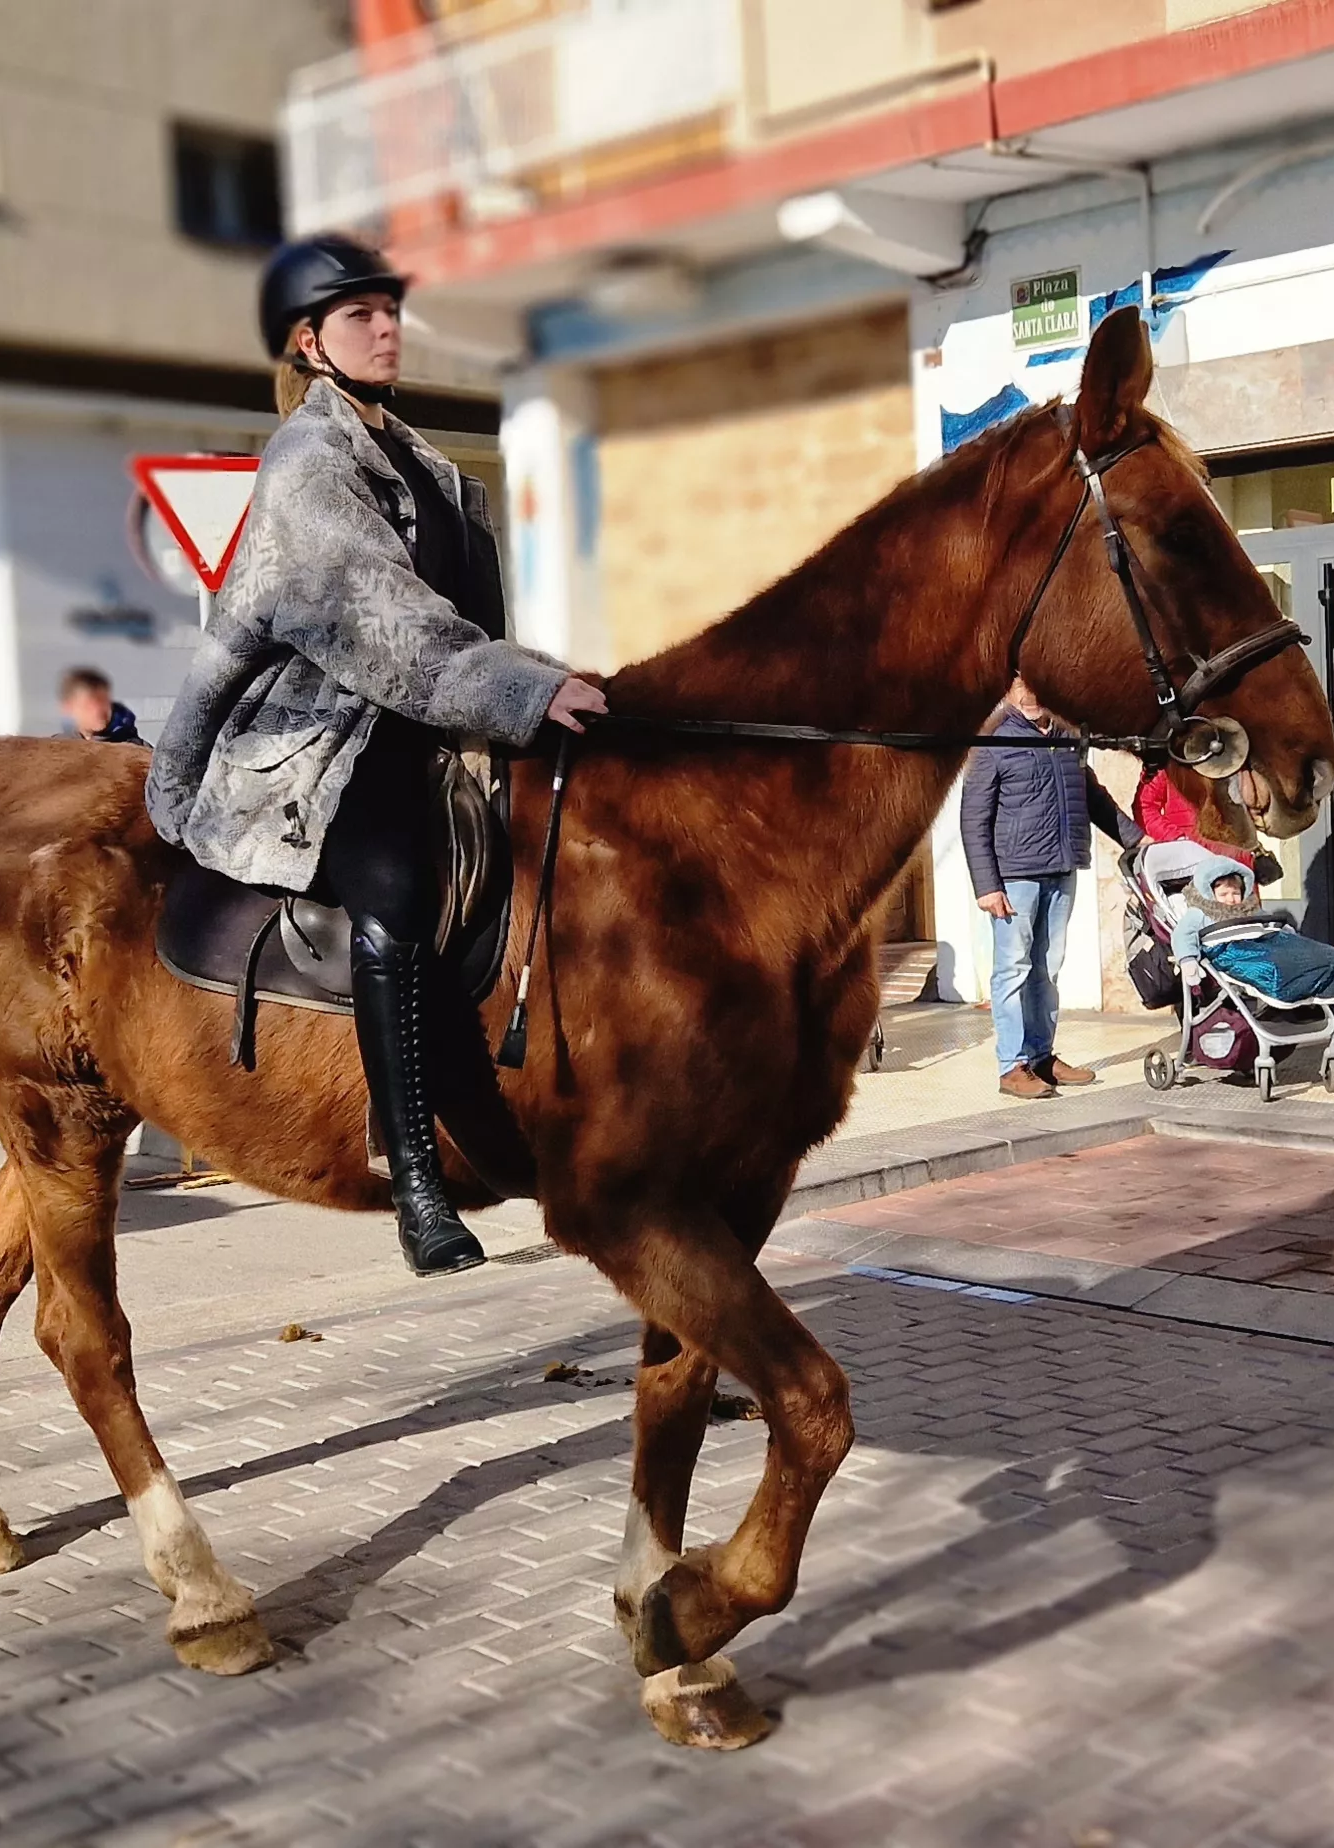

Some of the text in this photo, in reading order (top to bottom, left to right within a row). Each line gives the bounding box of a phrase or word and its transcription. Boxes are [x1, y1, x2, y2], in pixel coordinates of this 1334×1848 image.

[1033, 279, 1069, 296] Plaza
[1013, 311, 1078, 339] SANTA CLARA
